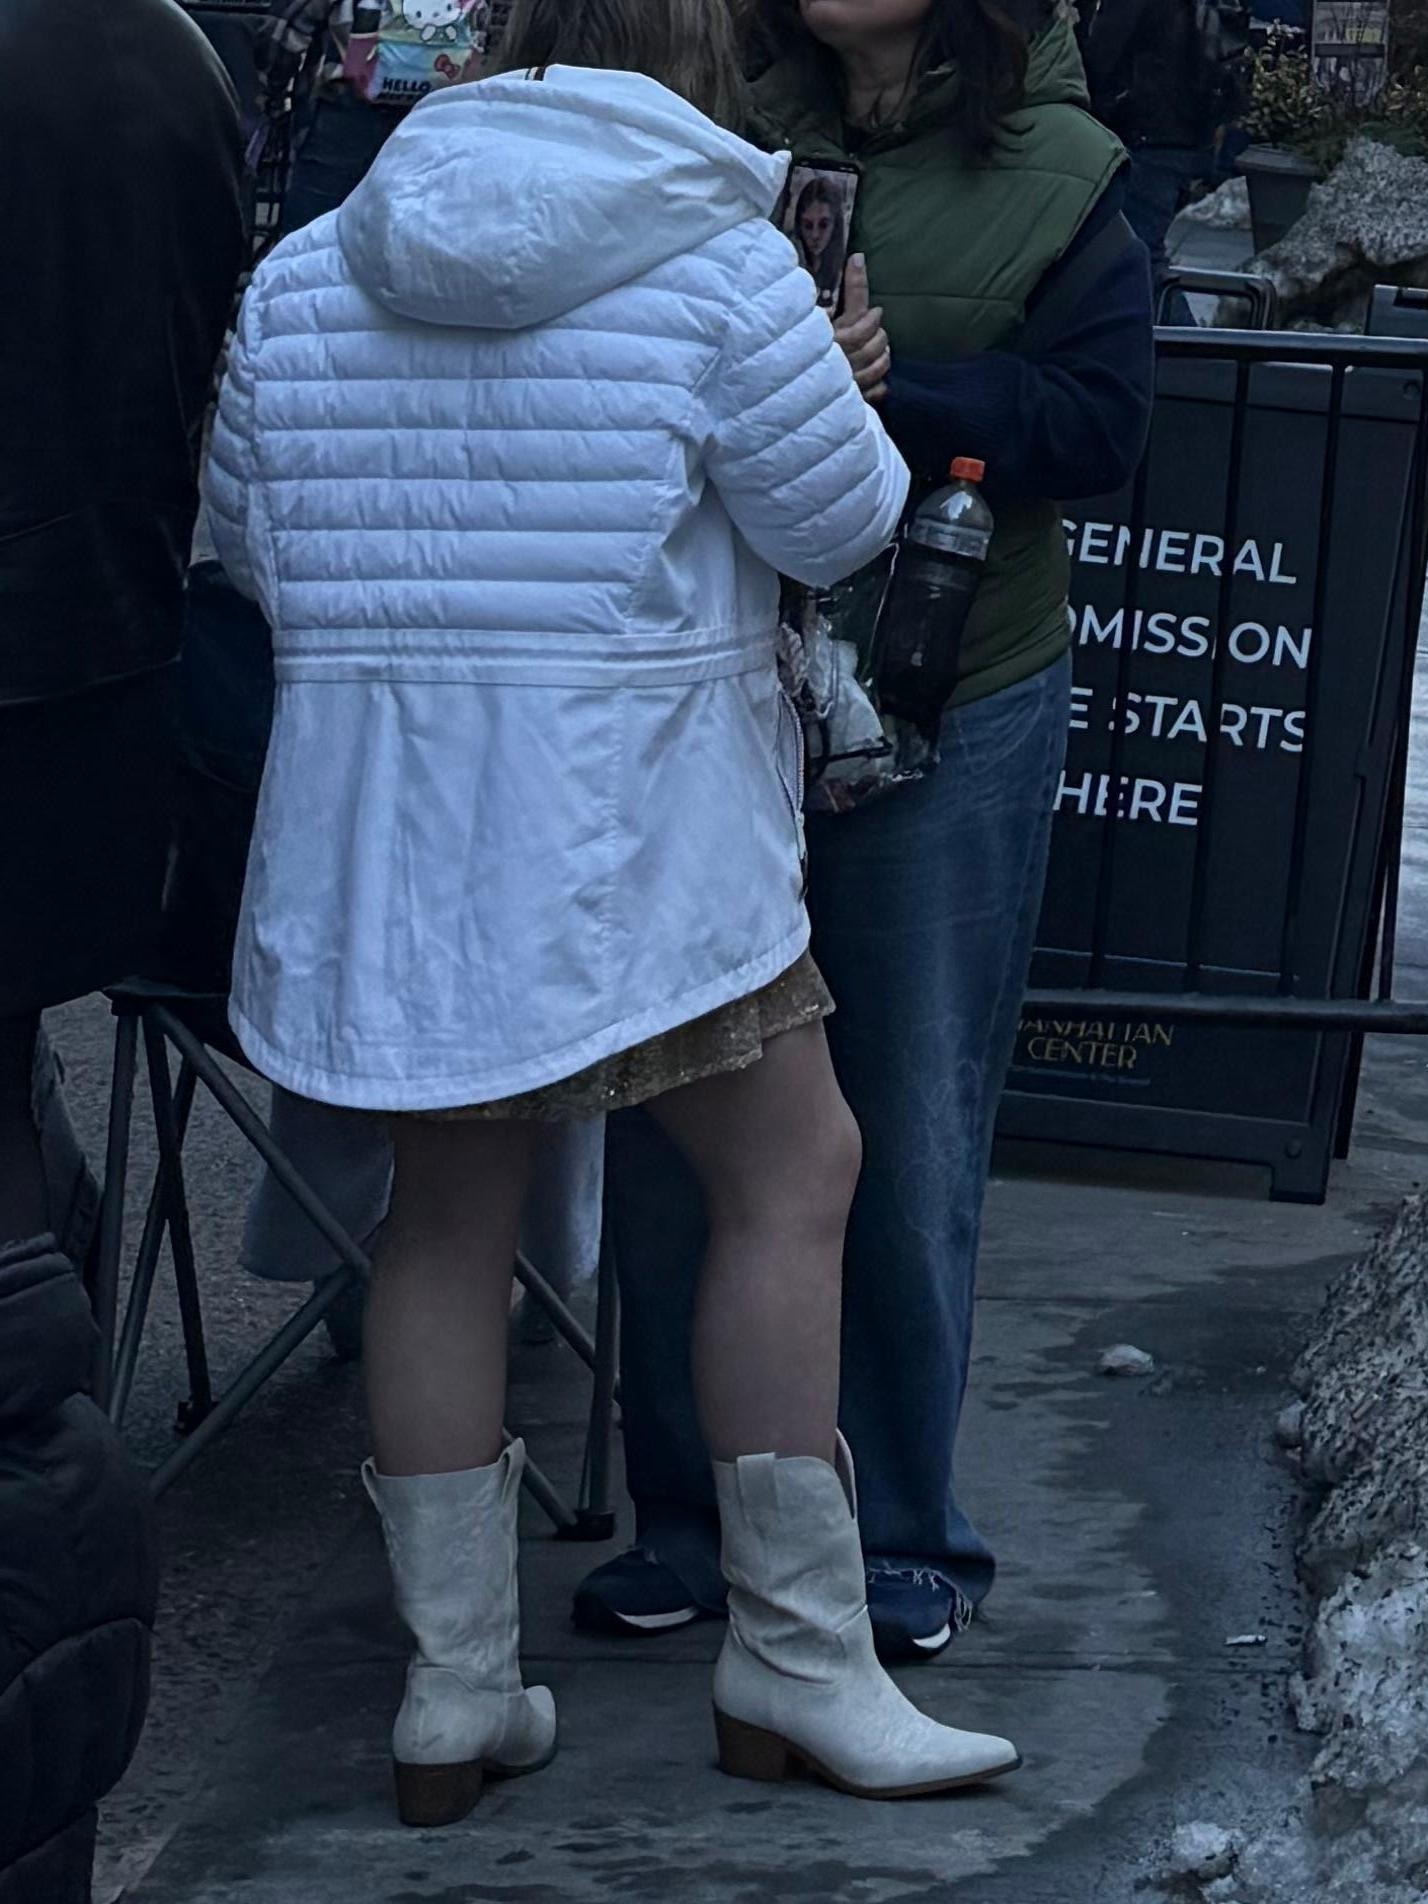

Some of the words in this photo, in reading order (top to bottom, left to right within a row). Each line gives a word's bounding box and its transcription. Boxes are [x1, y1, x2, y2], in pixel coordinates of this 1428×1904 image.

[382, 76, 433, 93] HELLO
[1051, 769, 1203, 826] HERE
[1027, 1036, 1138, 1069] CENTER
